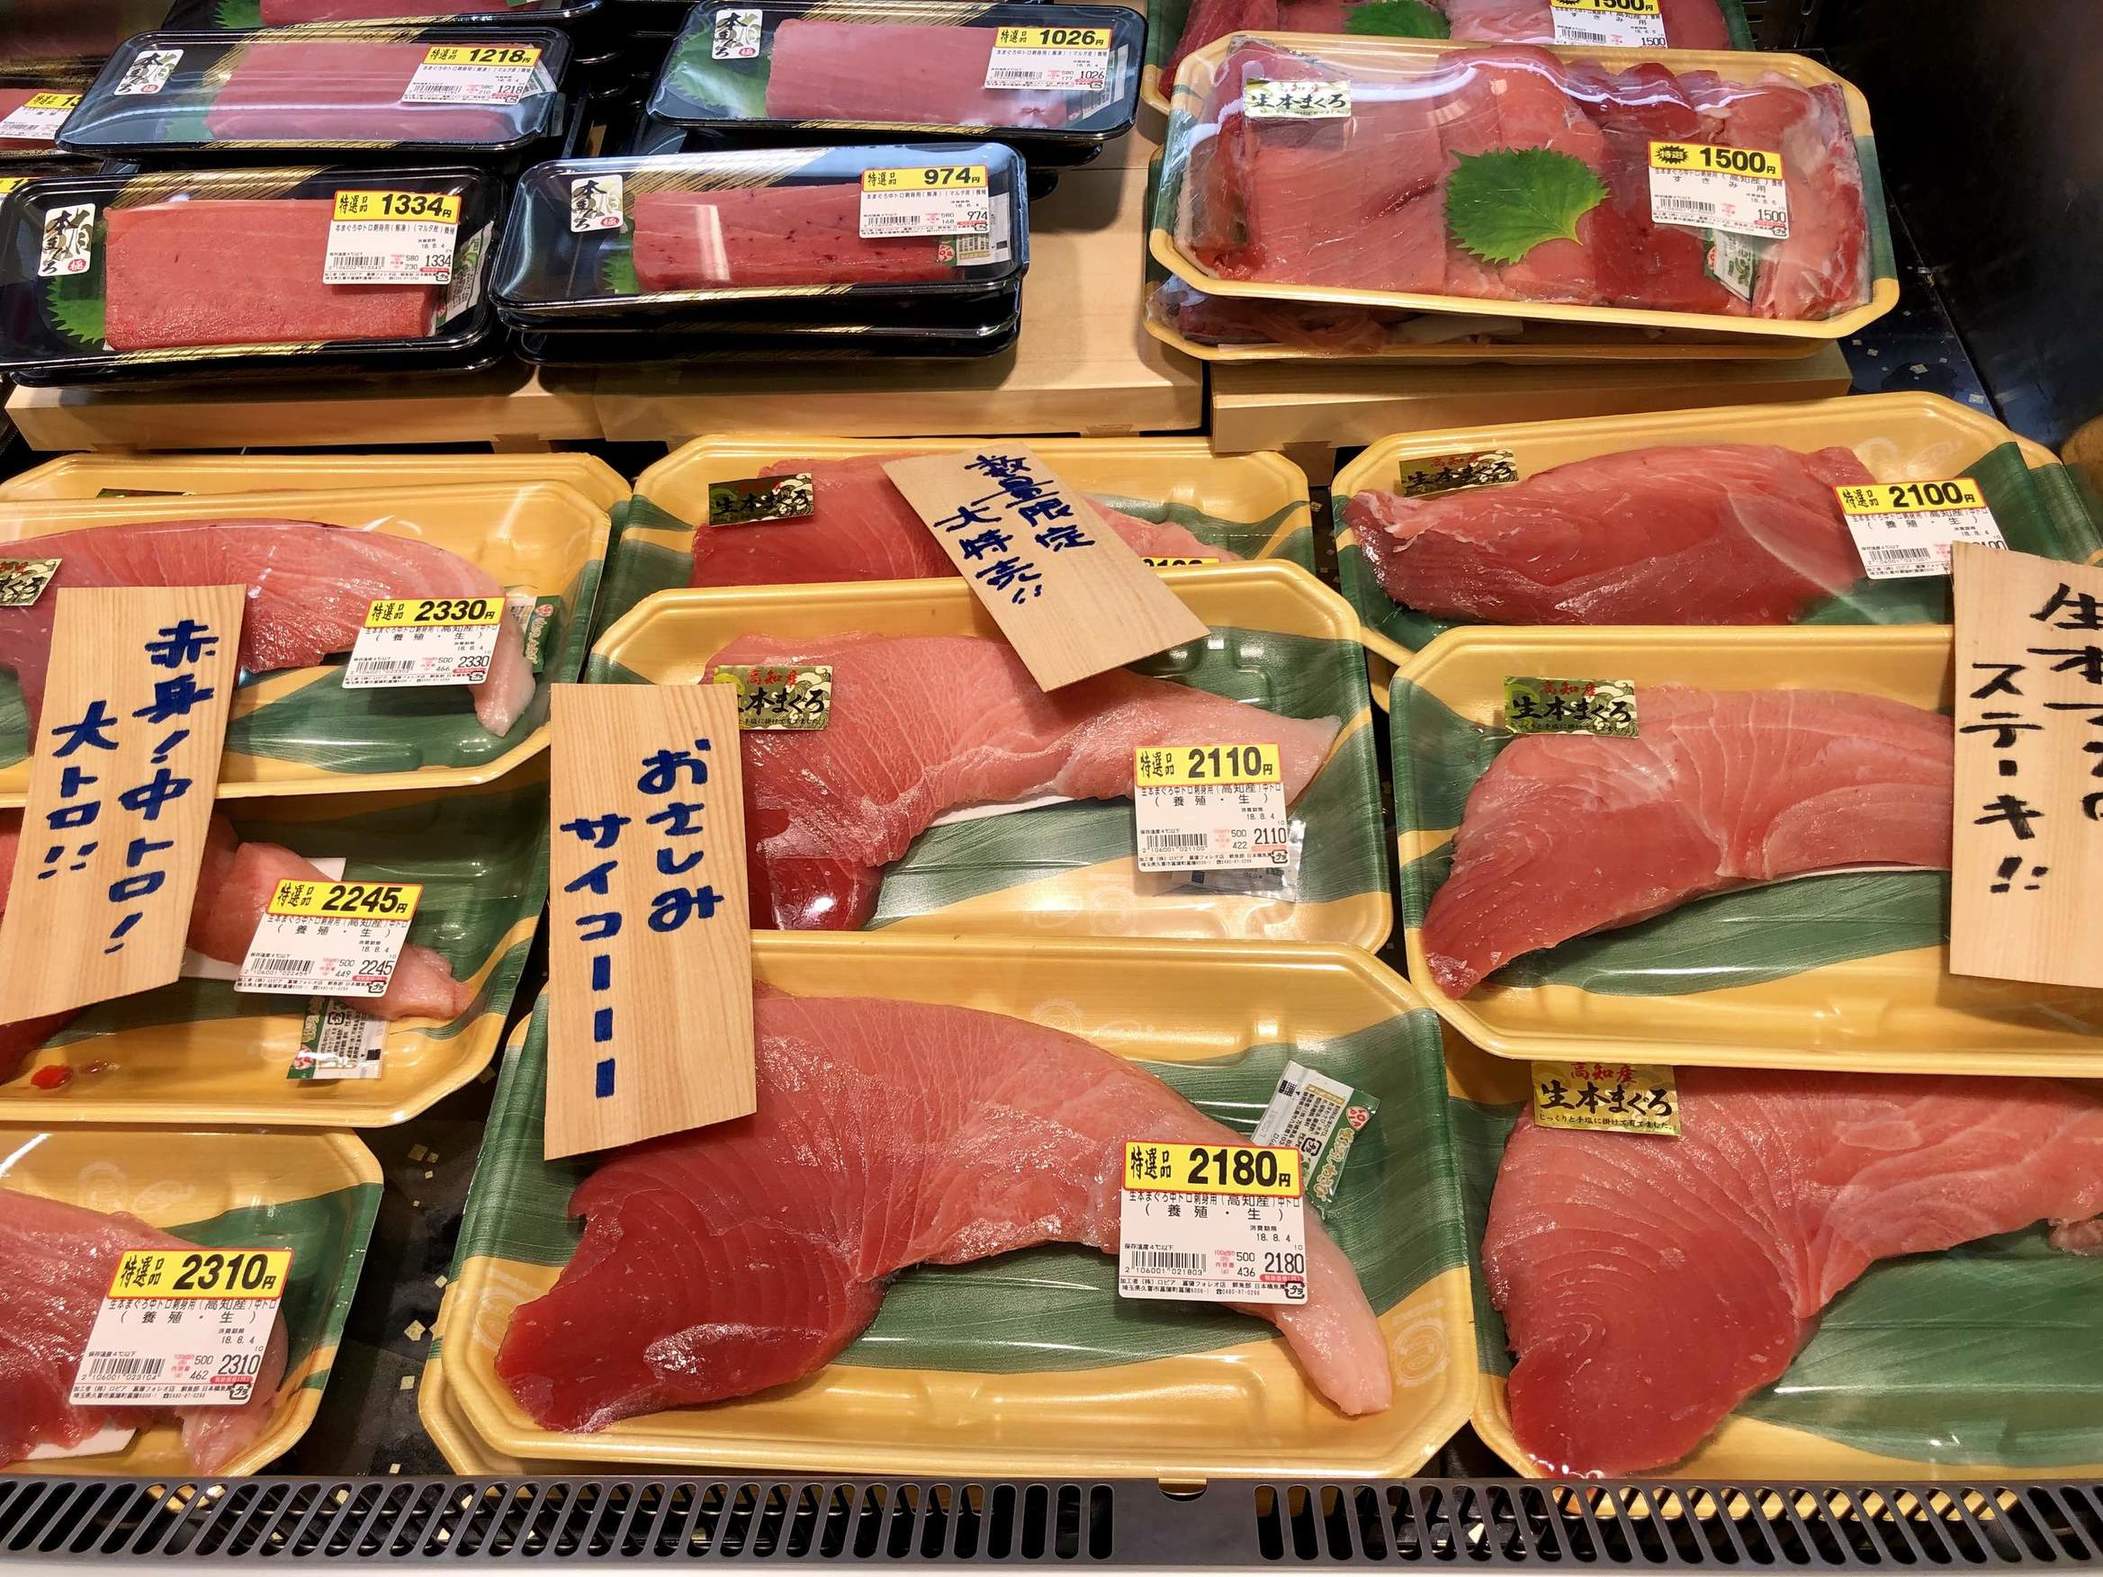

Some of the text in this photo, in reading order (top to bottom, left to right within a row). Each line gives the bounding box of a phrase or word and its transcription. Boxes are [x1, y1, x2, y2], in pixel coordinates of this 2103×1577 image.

[1040, 29, 1104, 46] 1026円
[469, 48, 531, 64] 1218円
[1080, 70, 1105, 80] 1026
[498, 85, 524, 94] 1218
[1699, 147, 1776, 174] 1500円
[924, 167, 980, 185] 974円
[382, 194, 452, 218] 1334円
[967, 211, 987, 220] 974
[1757, 208, 1787, 223] 1500
[425, 254, 451, 267] 1334
[965, 454, 1095, 551] 数量限定
[1888, 482, 1976, 508] 2100円
[415, 599, 495, 622] 2330円
[459, 655, 490, 668] 2330
[738, 686, 825, 716] 本まぐろ
[1511, 695, 1632, 722] 生本まぐろ
[1140, 746, 1273, 778] 特選品 2110円
[637, 738, 725, 933] おさしみ
[1231, 829, 1247, 838] 500
[1253, 827, 1287, 845] 2110
[1232, 841, 1248, 850] 422
[278, 883, 409, 914] 特選品 2245円
[339, 959, 355, 967] 500
[358, 959, 395, 976] 2245
[335, 970, 351, 978] 449
[1570, 1061, 1637, 1084] 高知産
[1540, 1079, 1673, 1117] 生本まぐろ
[1130, 1145, 1172, 1180] 特選品
[1187, 1147, 1291, 1188] 2180円
[1236, 1251, 1256, 1262] 500
[1264, 1251, 1305, 1275] 2180
[119, 1253, 278, 1291] 特選品 2310円
[1236, 1267, 1256, 1277] 436
[194, 1354, 214, 1365] 500
[218, 1354, 261, 1375] 2310
[189, 1370, 209, 1380] 462
